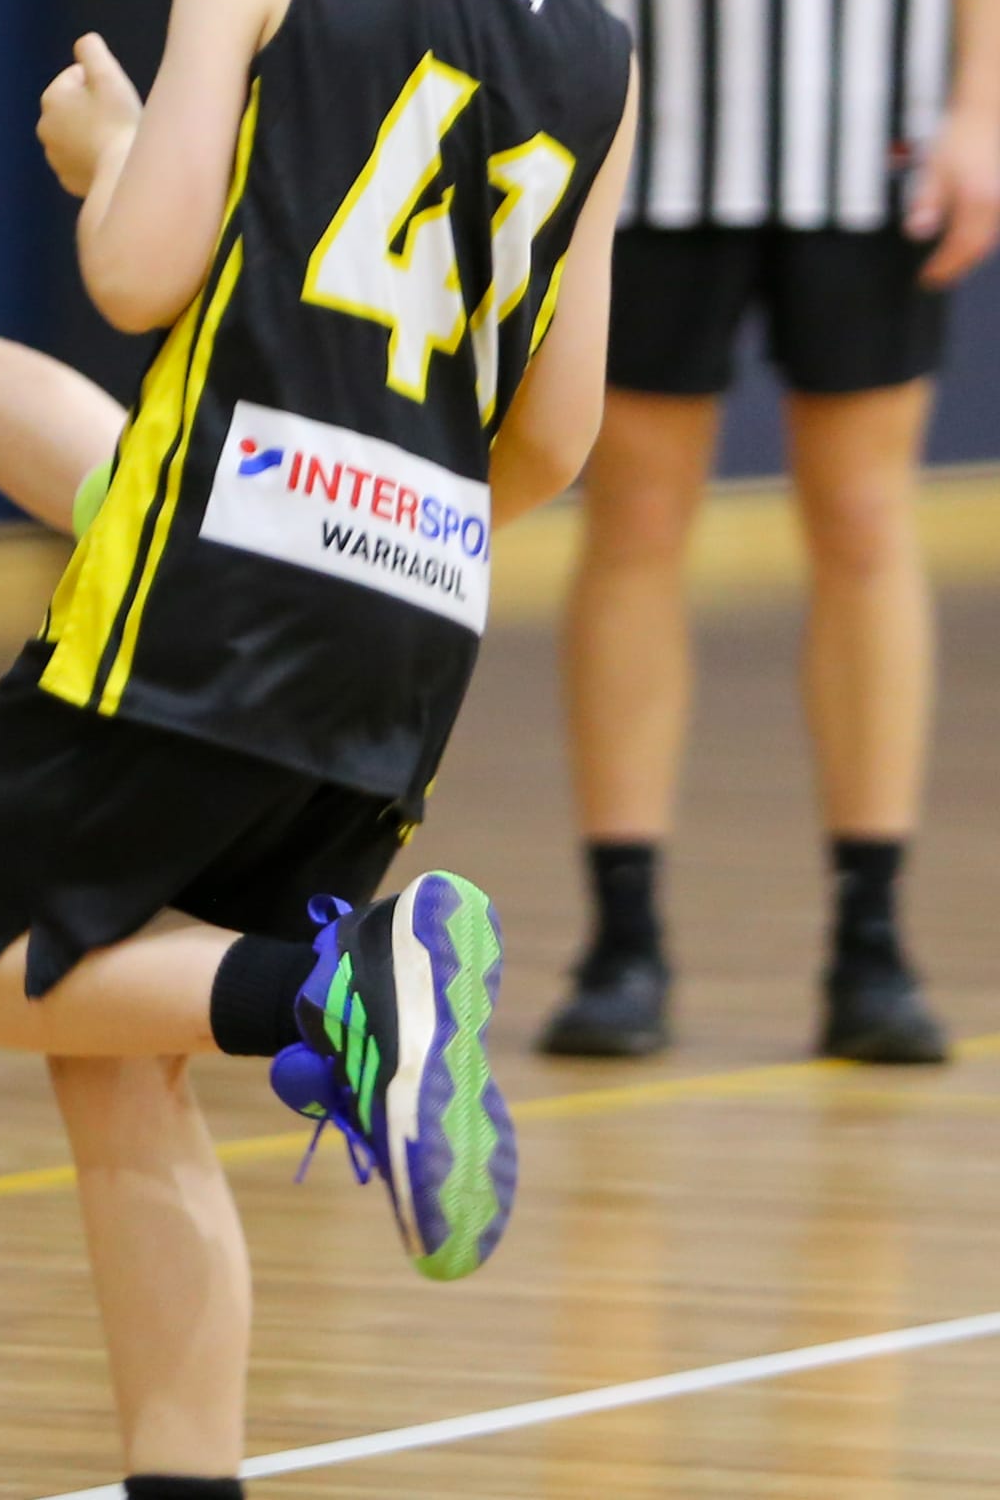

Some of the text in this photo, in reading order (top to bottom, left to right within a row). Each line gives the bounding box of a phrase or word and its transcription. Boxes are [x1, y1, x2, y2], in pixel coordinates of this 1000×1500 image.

[301, 48, 577, 427] 41
[287, 450, 488, 561] INTERSPO
[320, 519, 467, 602] WARRAGUL
